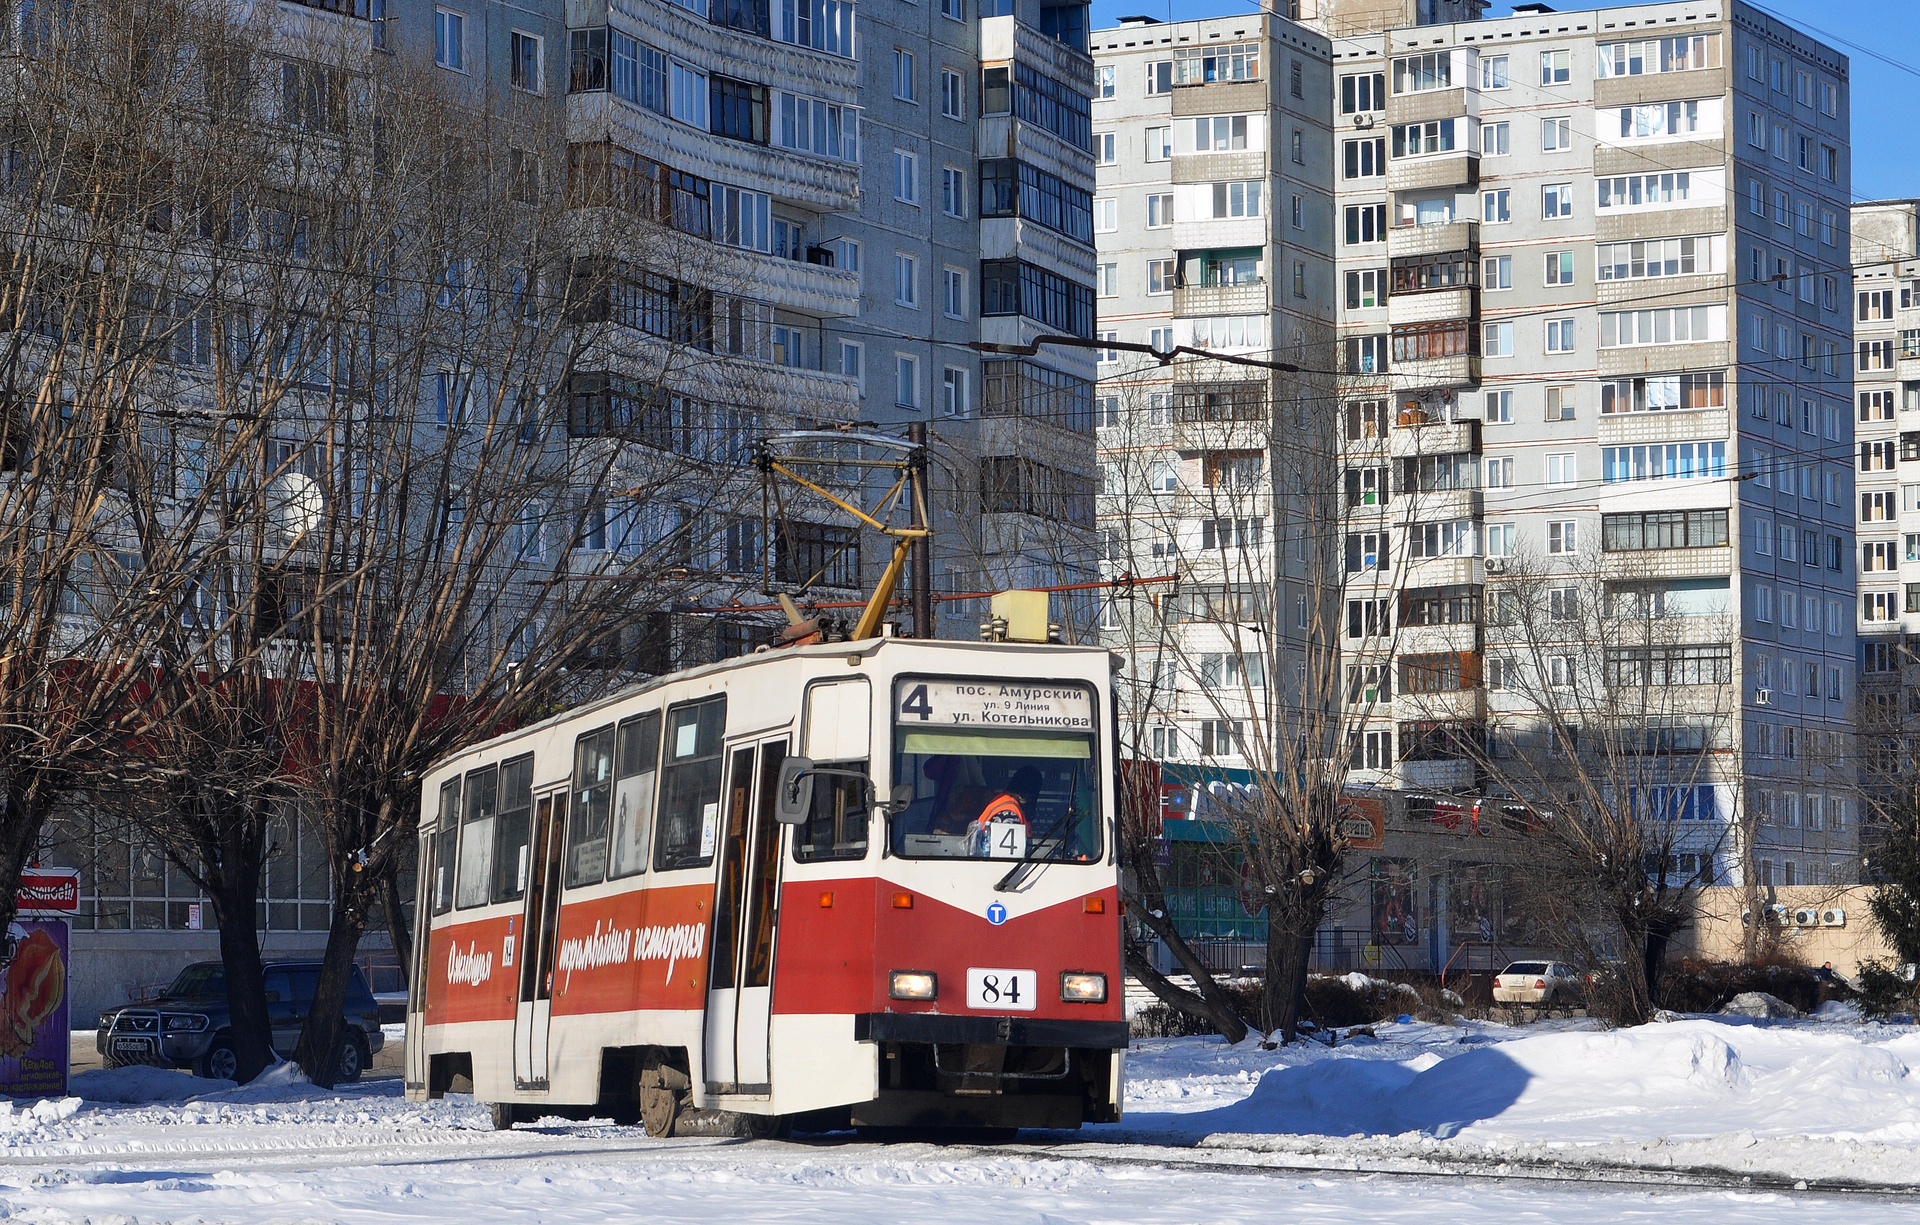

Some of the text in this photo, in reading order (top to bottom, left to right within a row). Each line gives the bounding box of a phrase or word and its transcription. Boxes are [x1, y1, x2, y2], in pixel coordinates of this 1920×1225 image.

[901, 684, 933, 721] 4
[956, 686, 1082, 700] пос. Амурский
[983, 701, 1050, 711] ул. 9 Линия
[952, 711, 1089, 727] ул. Котельникова
[999, 828, 1018, 855] 4
[505, 939, 514, 962] 84
[633, 921, 706, 987] история
[982, 974, 1021, 1004] 84
